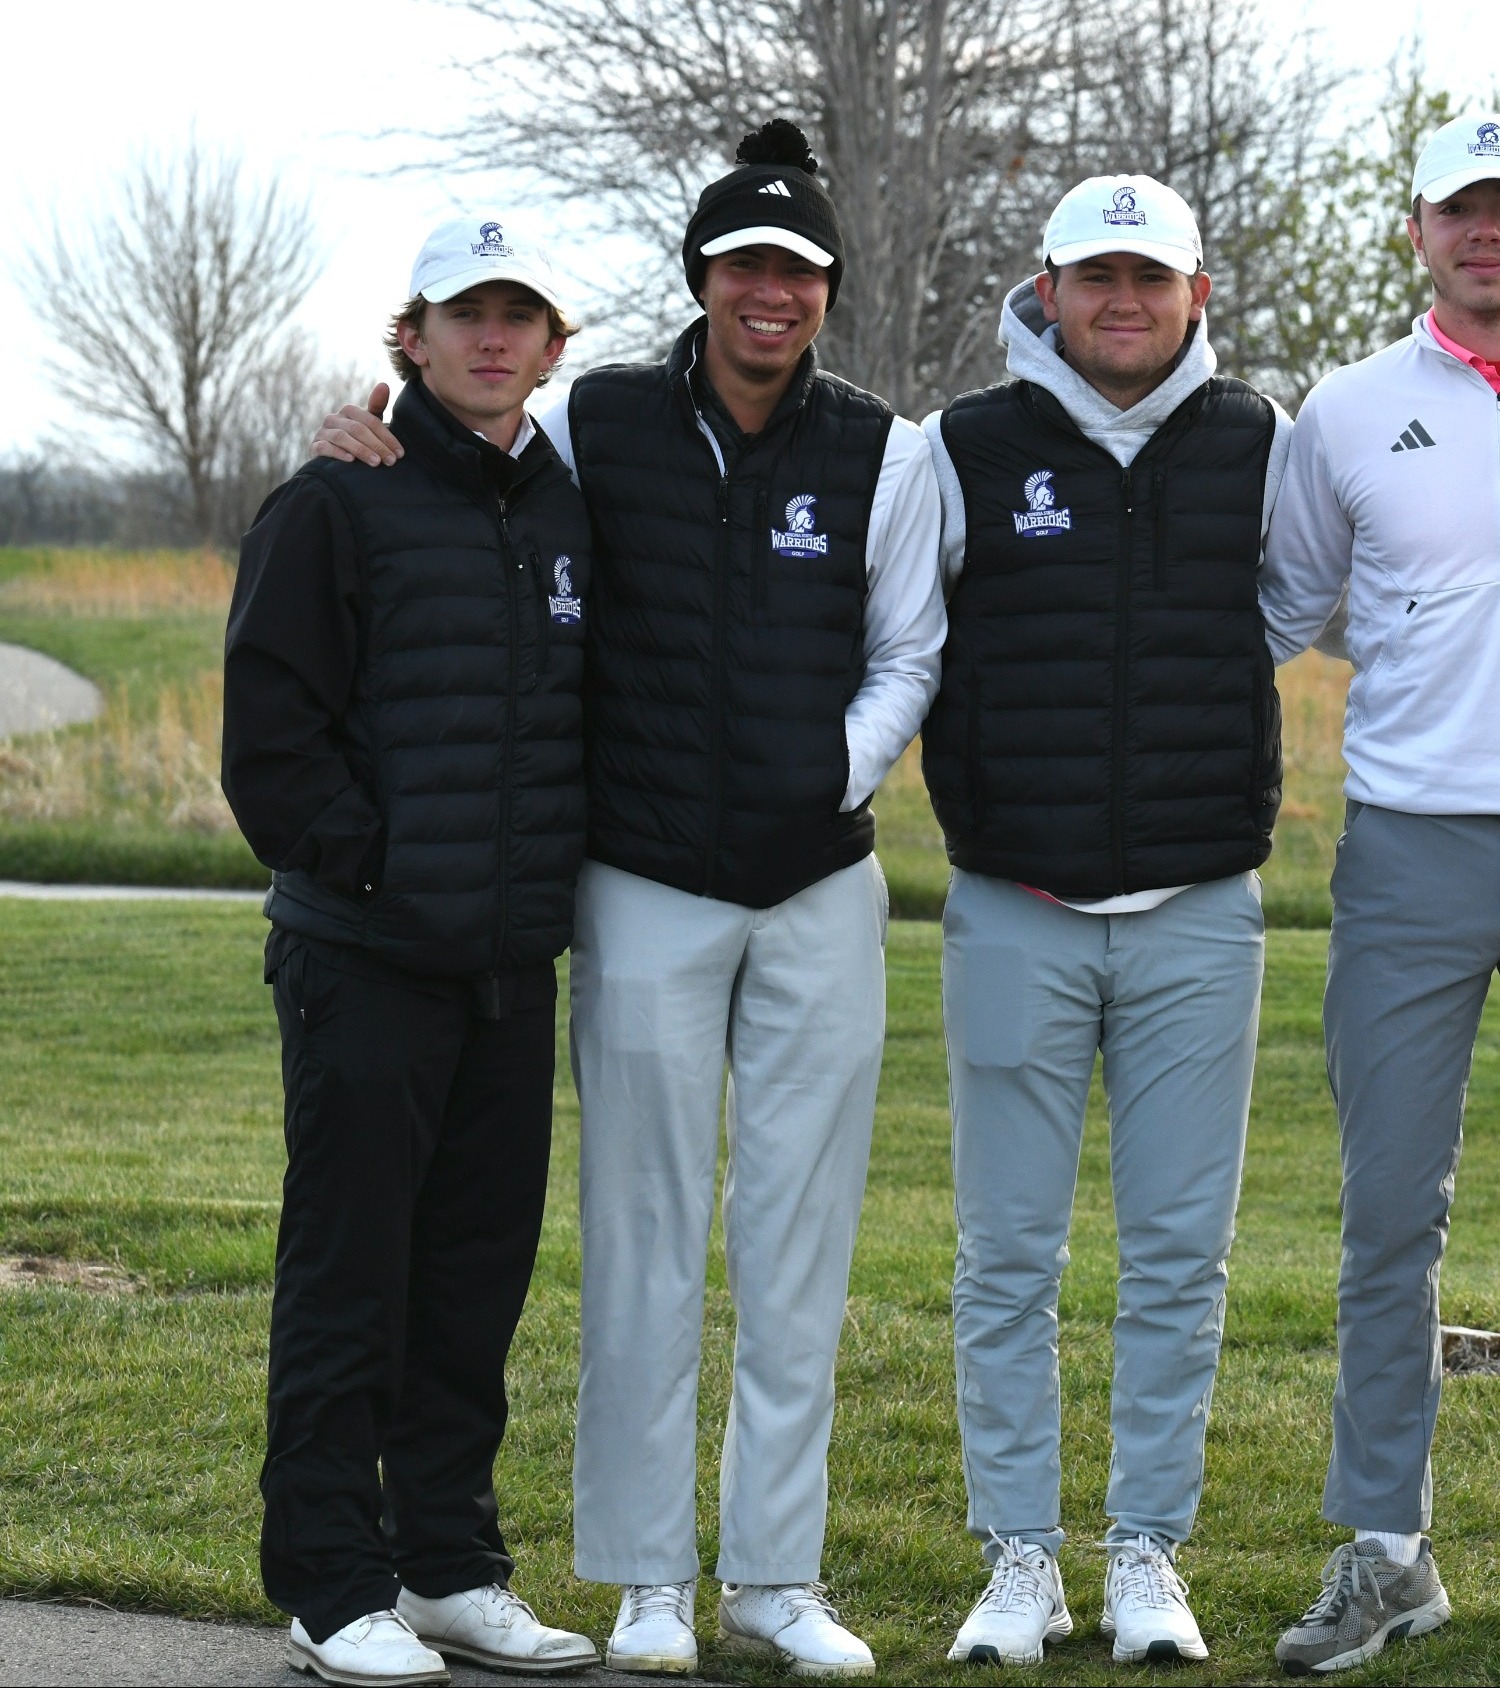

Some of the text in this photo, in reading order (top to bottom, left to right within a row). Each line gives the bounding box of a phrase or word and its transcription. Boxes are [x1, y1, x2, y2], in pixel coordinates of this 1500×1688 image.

[1103, 209, 1147, 225] WARRIORS
[1013, 508, 1071, 534] WARRIORS
[771, 529, 827, 554] WARRIORS
[548, 595, 581, 618] WARRIORS
